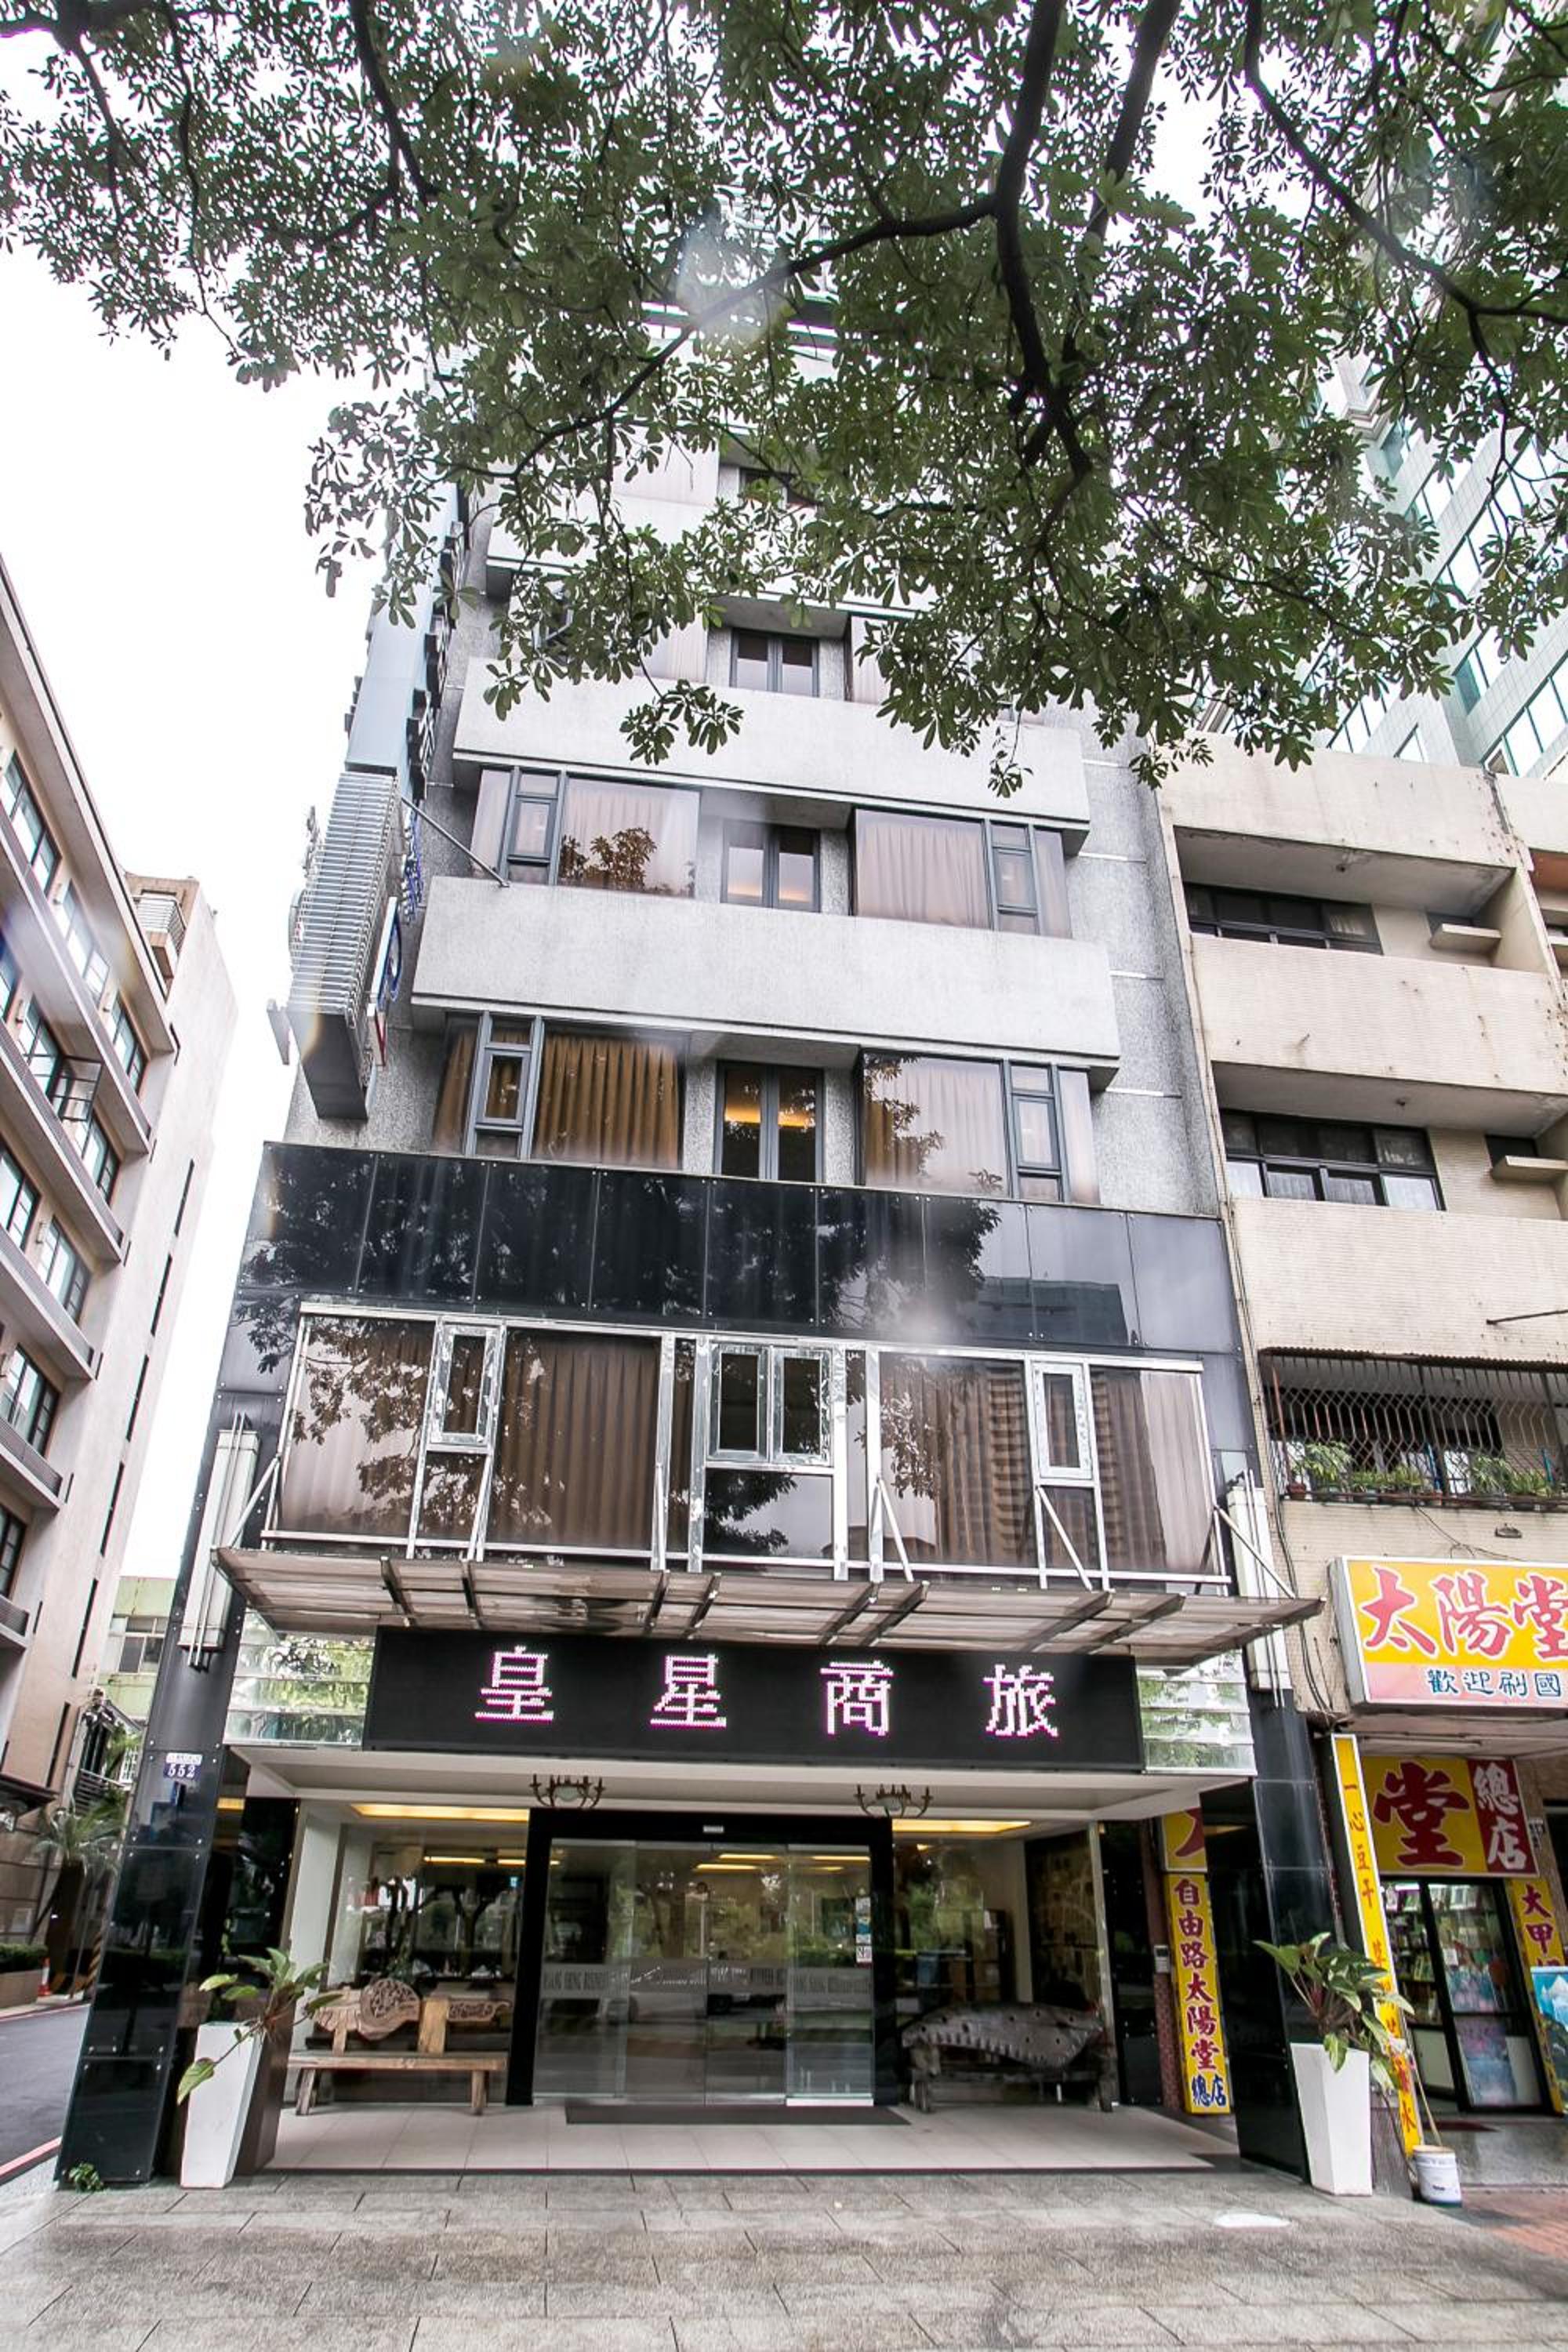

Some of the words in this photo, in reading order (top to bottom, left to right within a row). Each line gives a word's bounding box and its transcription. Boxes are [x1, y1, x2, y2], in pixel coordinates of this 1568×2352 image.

[1362, 1567, 1568, 1659] 太陽堂
[475, 1646, 1058, 1737] 皇星商旅
[1428, 1669, 1561, 1697] 歡迎刷國
[1344, 1784, 1375, 1907] 一心豆干
[1373, 1762, 1470, 1867] 堂
[1473, 1762, 1526, 1871] 總店
